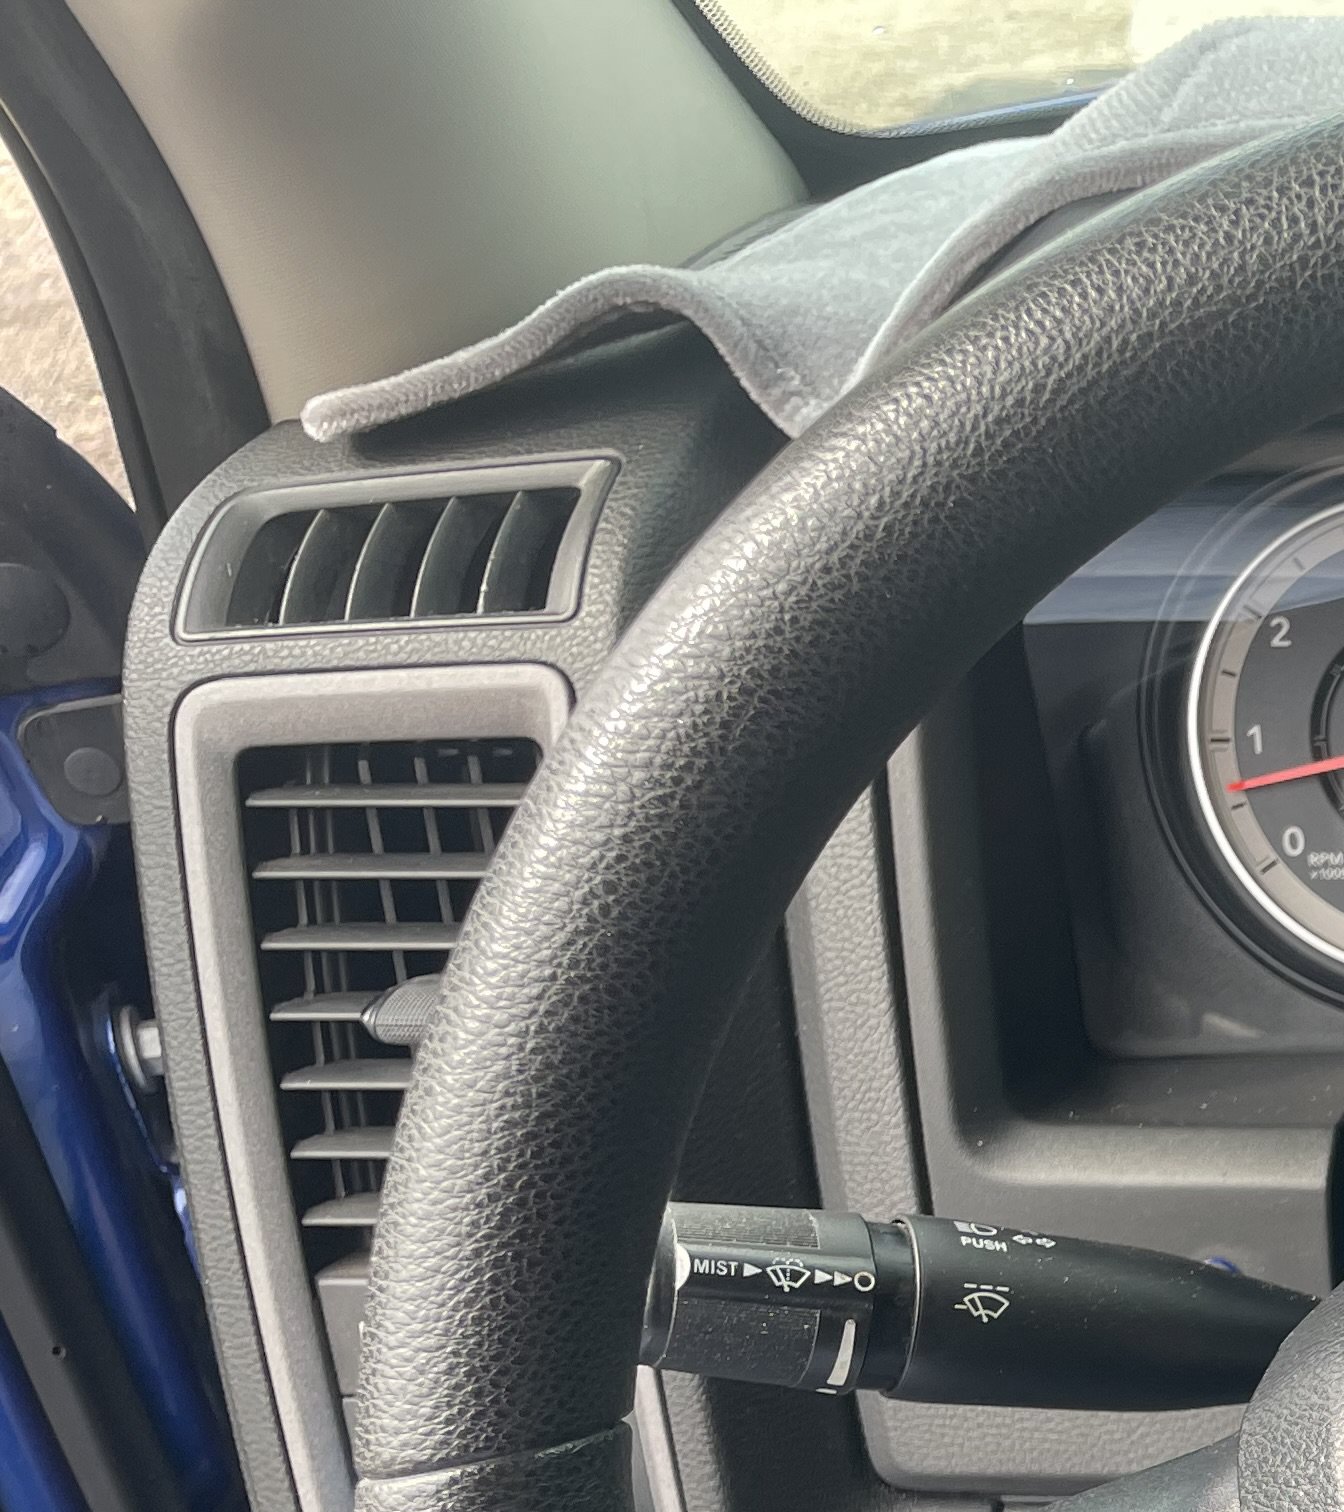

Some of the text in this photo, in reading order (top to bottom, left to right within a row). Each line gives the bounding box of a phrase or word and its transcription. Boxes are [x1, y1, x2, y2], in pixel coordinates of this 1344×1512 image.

[1269, 617, 1292, 648] 2
[1246, 723, 1264, 755] 1
[1282, 826, 1305, 857] 0
[1307, 851, 1344, 867] RPM
[960, 1235, 1008, 1252] PUSH
[693, 1259, 739, 1277] MIST
